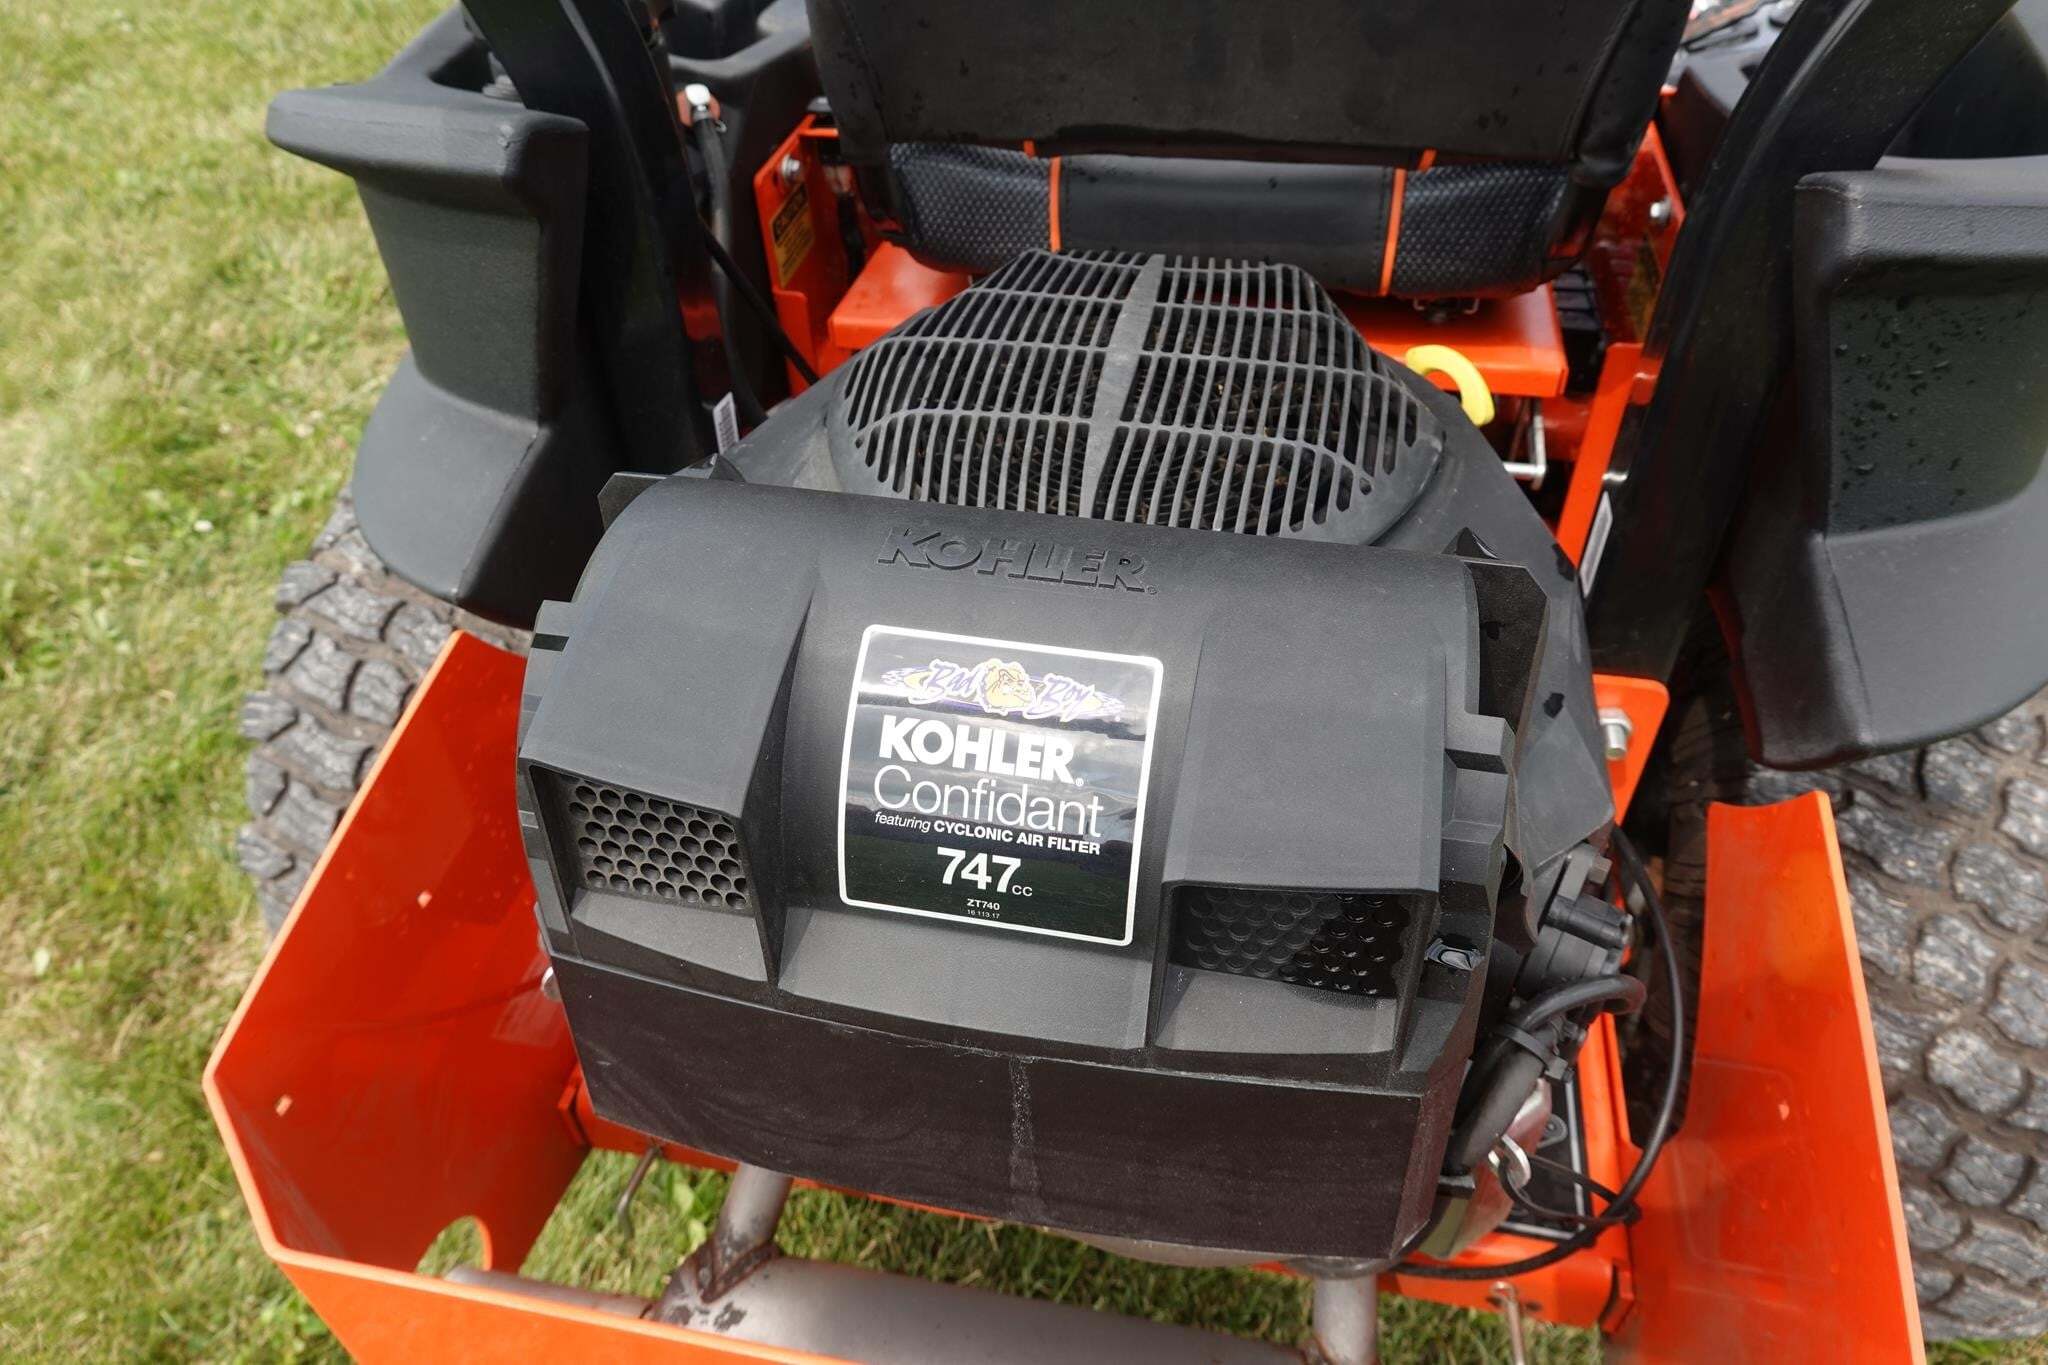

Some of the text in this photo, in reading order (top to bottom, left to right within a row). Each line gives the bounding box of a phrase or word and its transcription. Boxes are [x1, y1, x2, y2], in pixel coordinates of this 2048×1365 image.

[877, 527, 1145, 593] KOHLER
[879, 714, 1074, 786] KOHLER
[874, 764, 1104, 837] Confidant
[874, 811, 1101, 855] featuring CYCLONIC AIR FILTER
[966, 898, 1000, 911] ZT740
